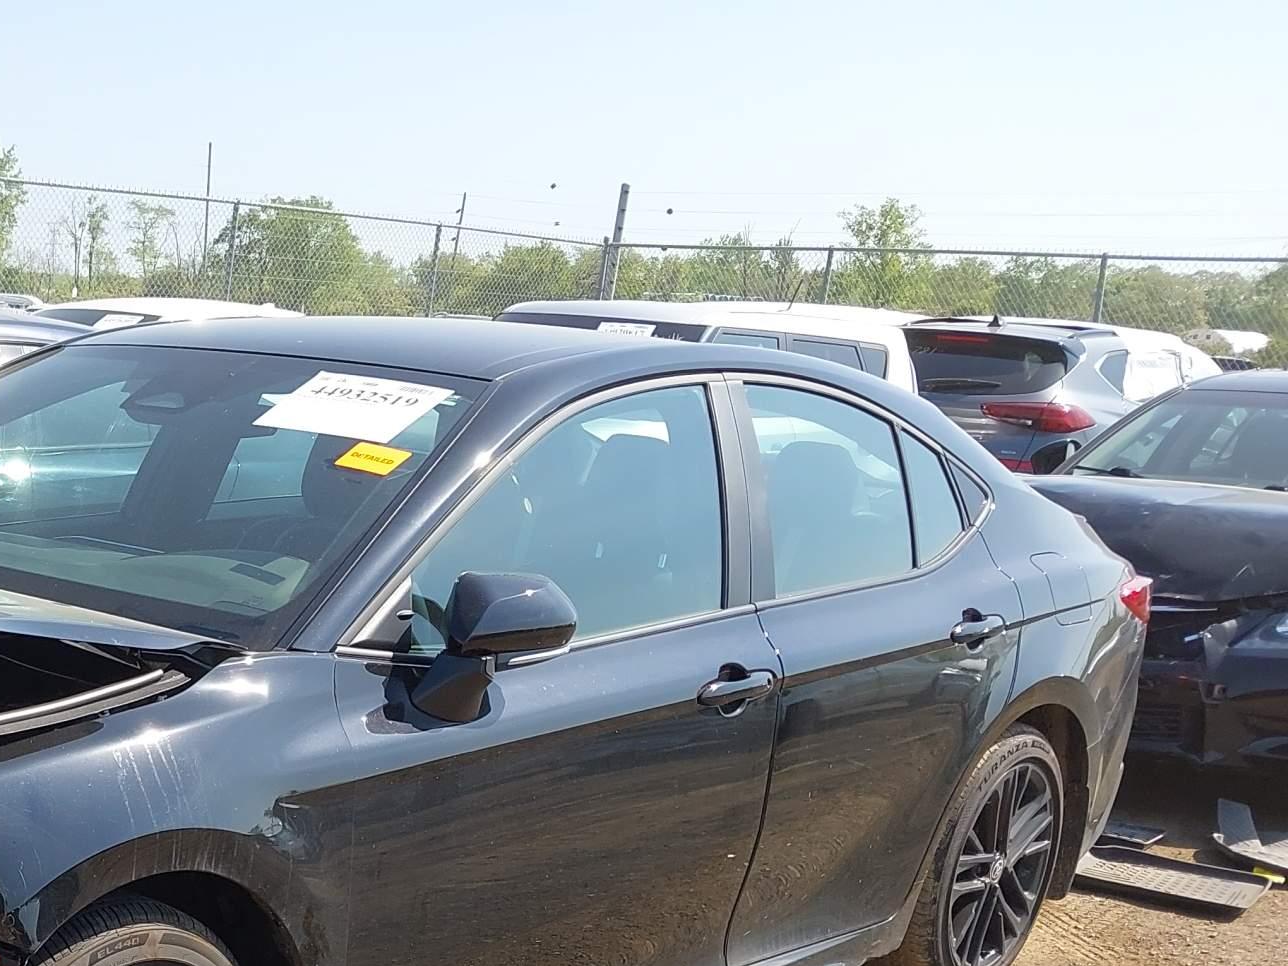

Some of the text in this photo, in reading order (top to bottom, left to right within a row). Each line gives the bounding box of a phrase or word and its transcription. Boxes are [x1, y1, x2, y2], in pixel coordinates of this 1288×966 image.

[311, 385, 419, 407] 44932519
[350, 451, 395, 465] DETAILED
[976, 741, 1029, 792] TURANZA
[97, 937, 141, 960] EL440
